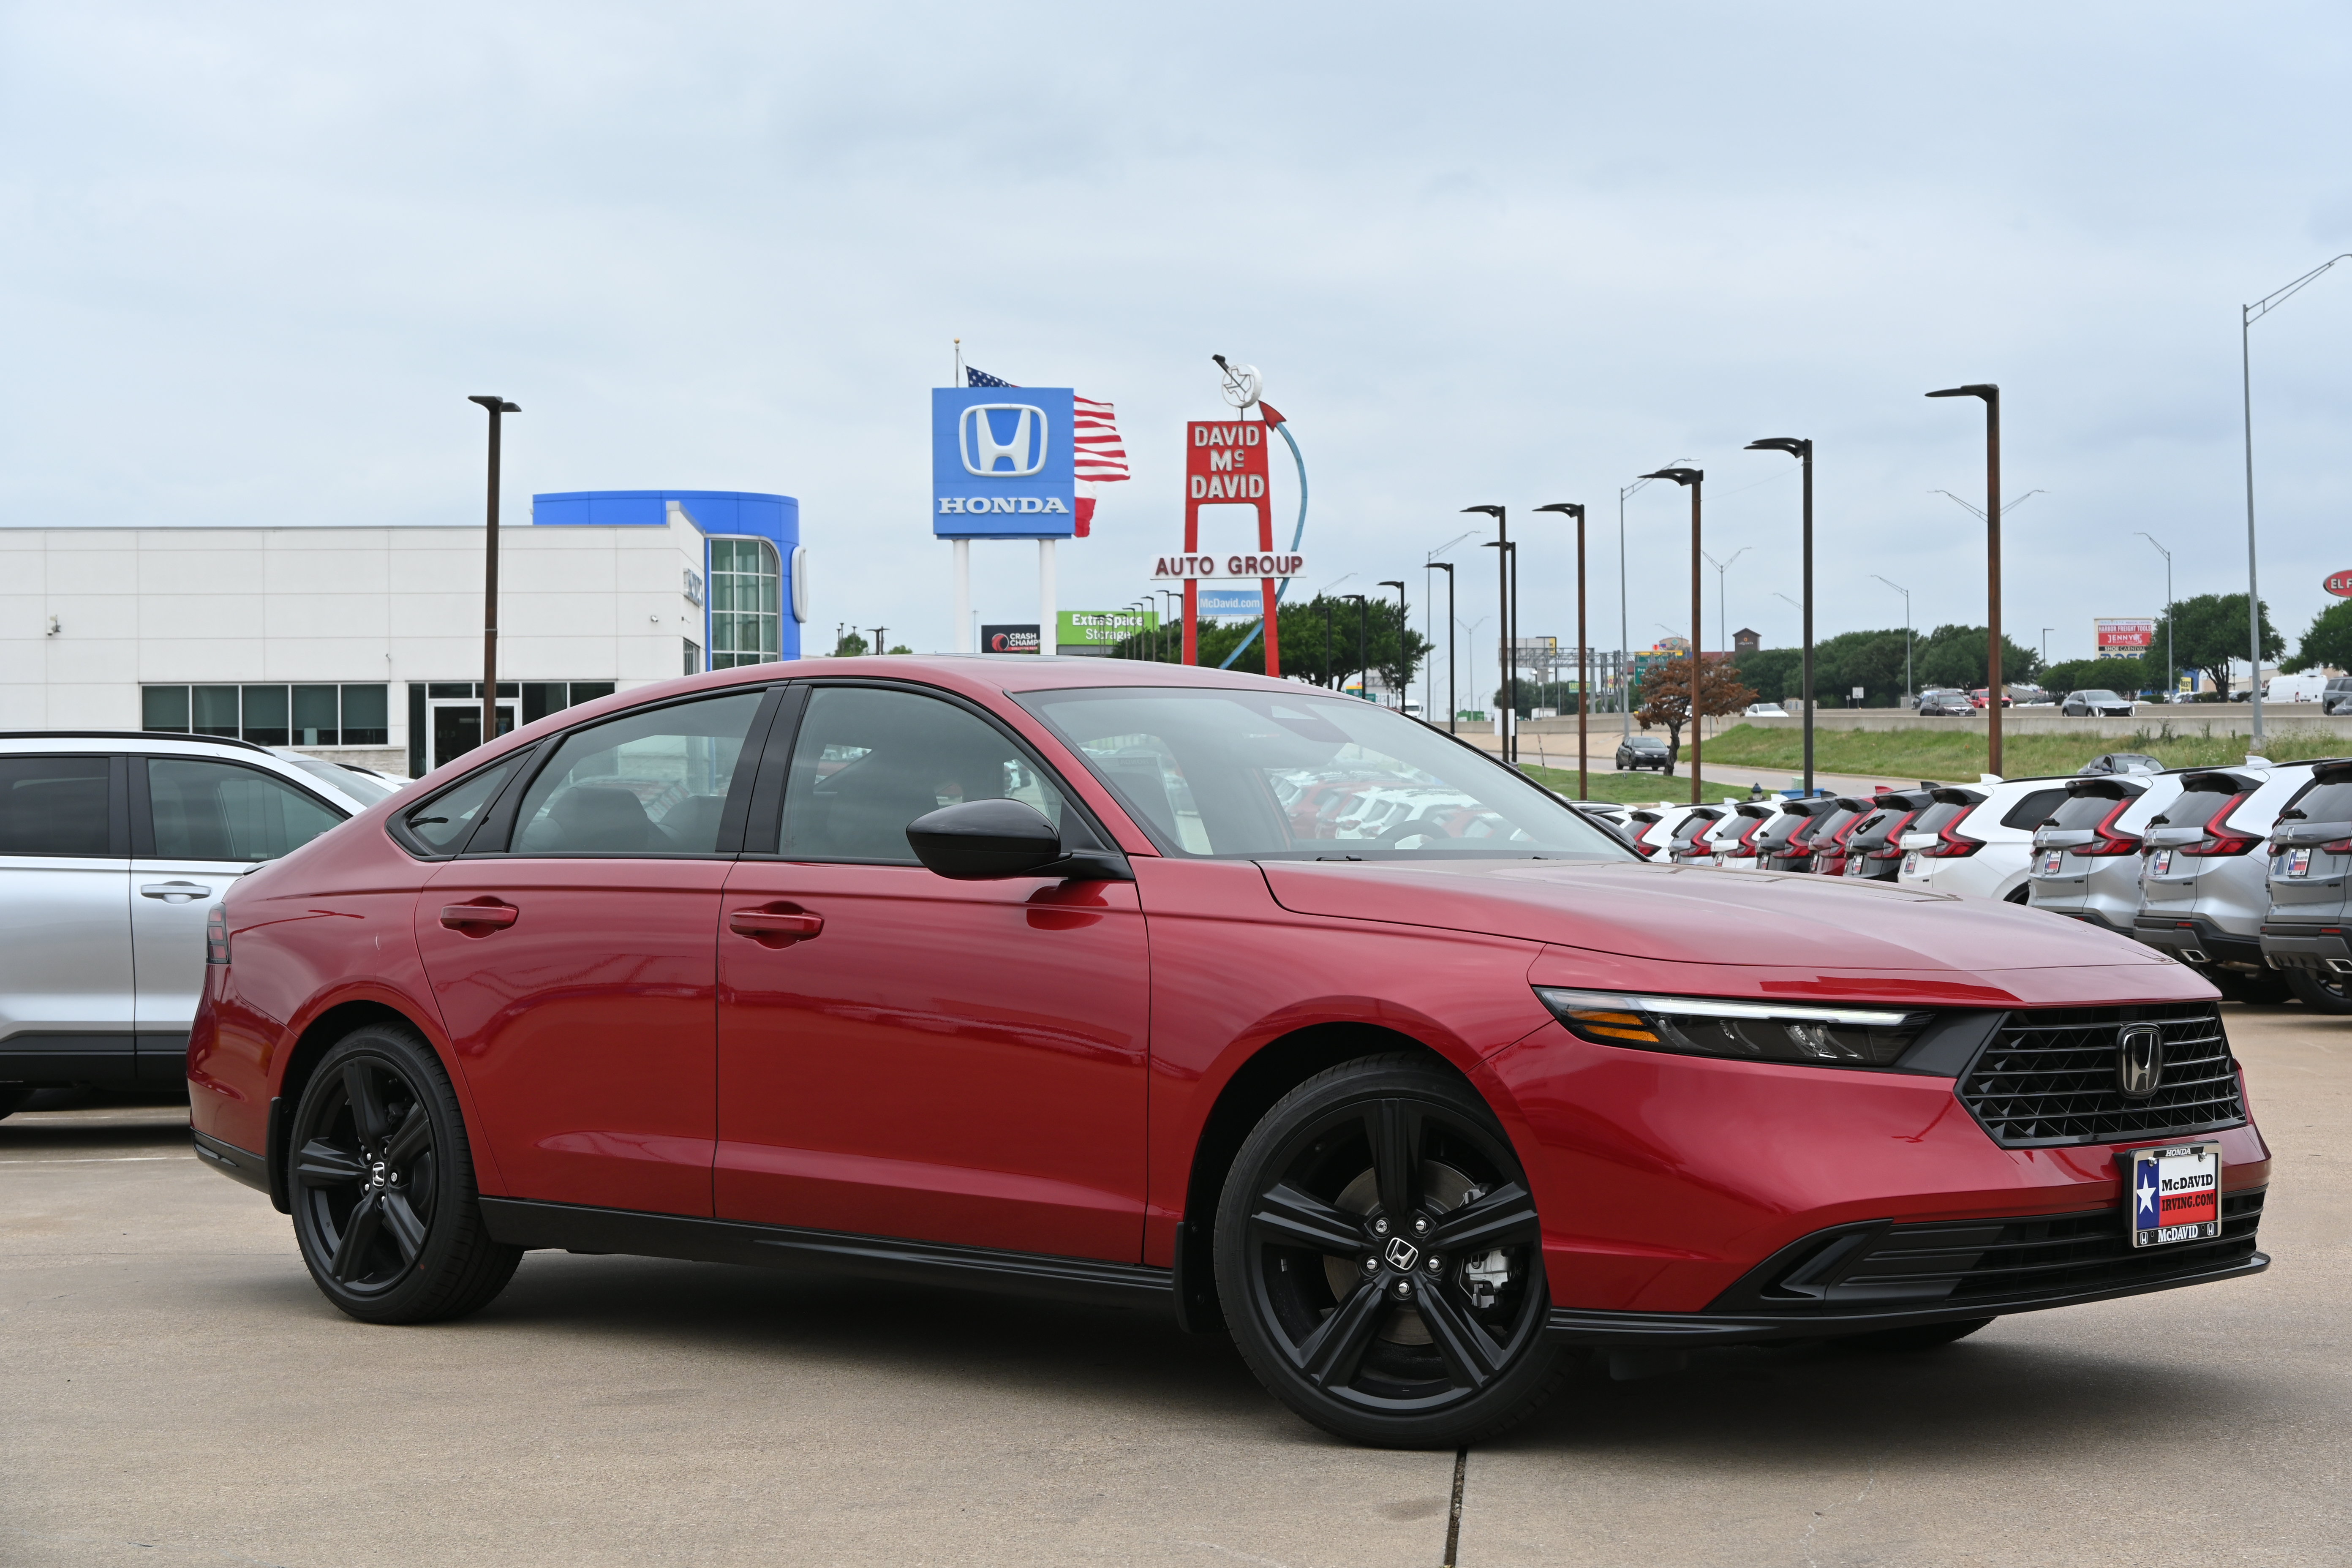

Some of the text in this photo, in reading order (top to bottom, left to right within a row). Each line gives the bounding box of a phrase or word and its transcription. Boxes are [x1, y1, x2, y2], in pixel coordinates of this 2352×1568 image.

[1195, 426, 1260, 446] DAVID
[1210, 449, 1244, 471] Mc
[1191, 474, 1264, 498] DAVID
[938, 497, 1069, 514] HONDA
[1155, 555, 1303, 576] AUTO GROUP
[2331, 578, 2344, 589] EL
[1200, 598, 1260, 608] McDavid.com
[1086, 628, 1131, 642] Storage
[2107, 634, 2133, 644] JENNY
[2165, 1148, 2191, 1157] HONDA
[2161, 1174, 2213, 1192] McDAVID
[2161, 1192, 2214, 1211] IRVING.COM
[2157, 1225, 2198, 1243] McDAVID
